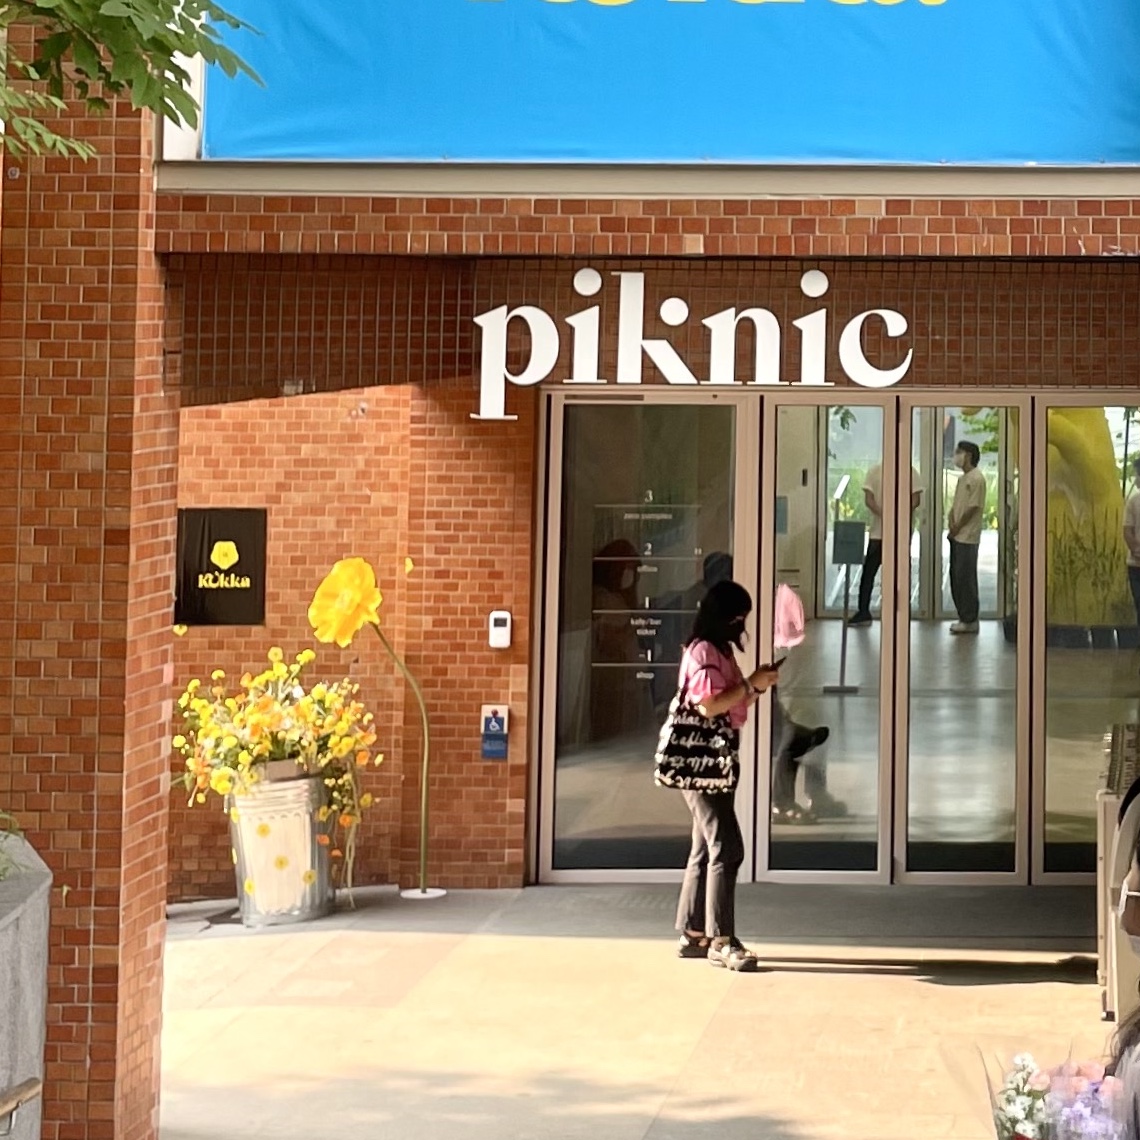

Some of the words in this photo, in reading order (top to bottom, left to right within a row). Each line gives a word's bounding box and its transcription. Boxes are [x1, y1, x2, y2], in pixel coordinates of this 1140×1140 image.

[470, 267, 914, 420] piknic
[644, 489, 654, 503] 3
[643, 542, 653, 556] 2
